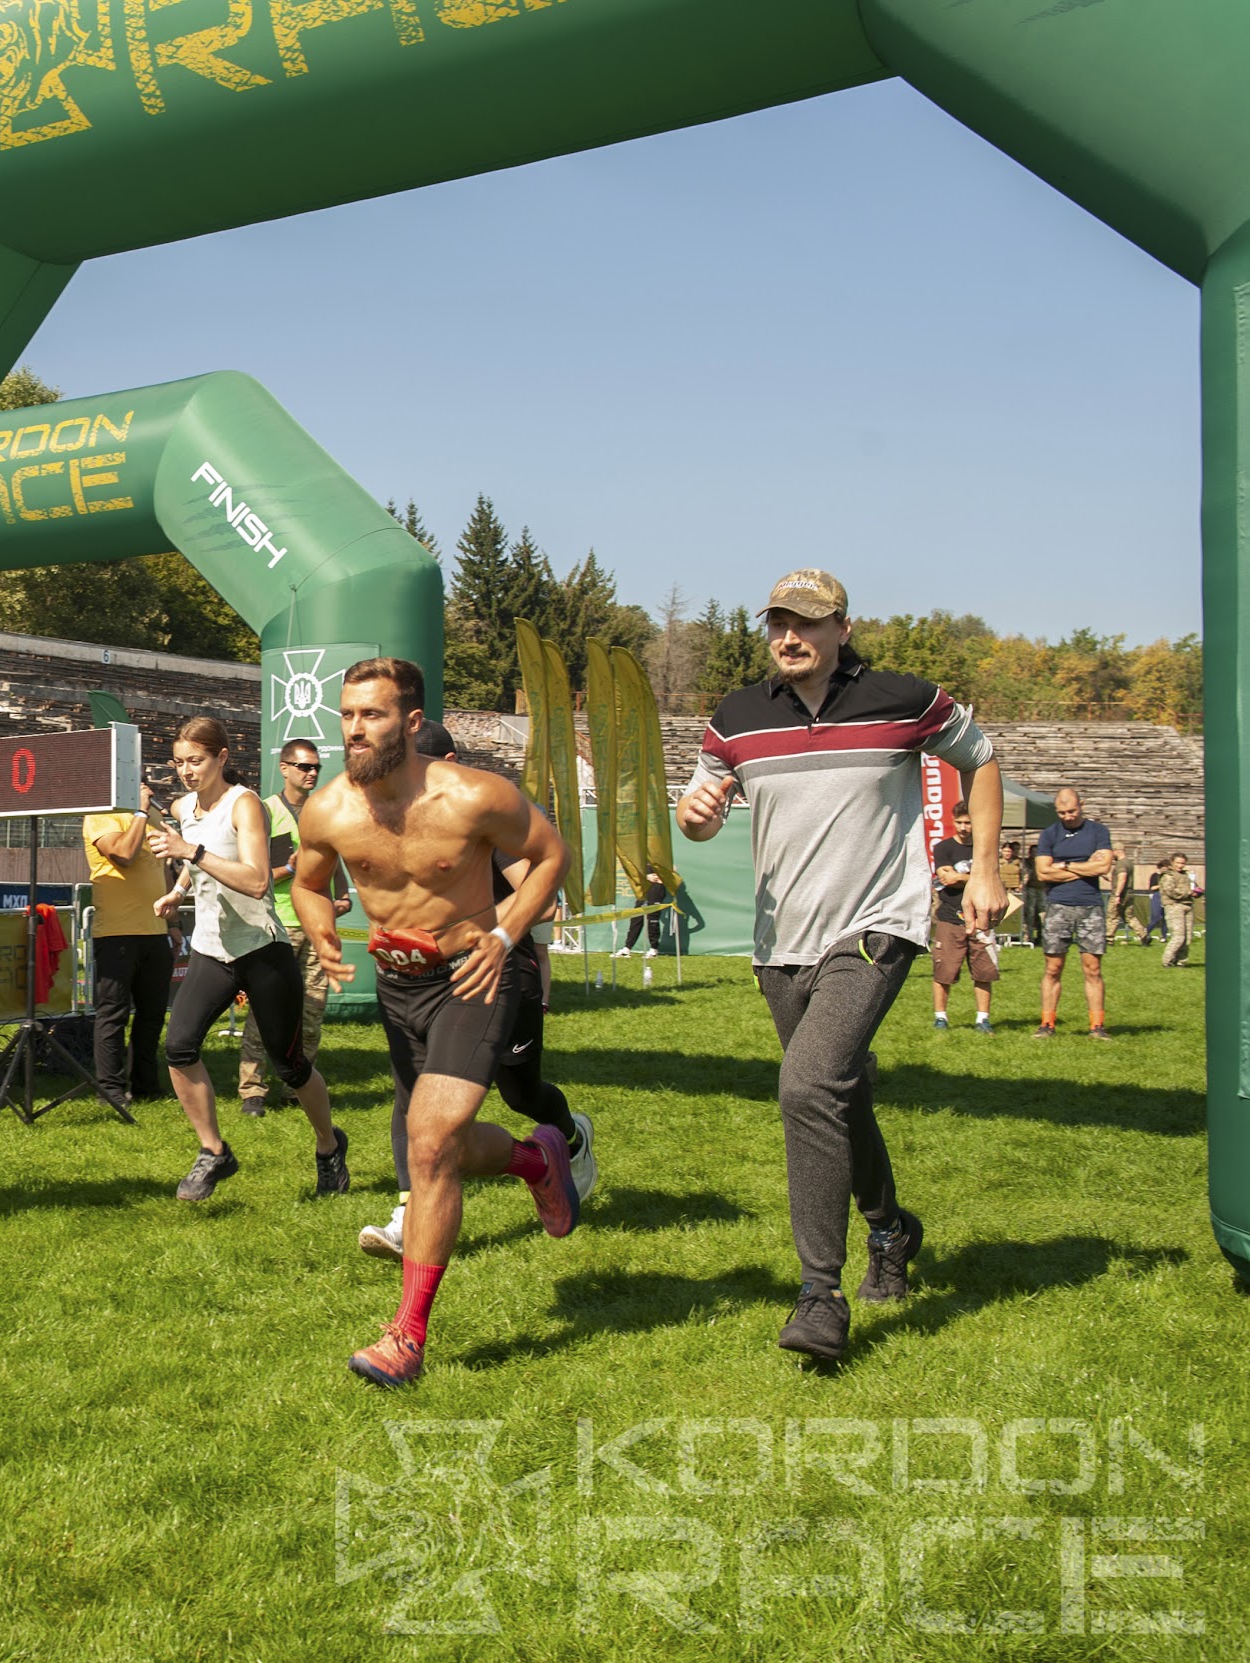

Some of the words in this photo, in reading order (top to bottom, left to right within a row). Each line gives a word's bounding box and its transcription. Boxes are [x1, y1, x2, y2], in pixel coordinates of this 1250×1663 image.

[190, 461, 288, 569] FINISH
[103, 649, 110, 663] 6
[12, 748, 36, 794] 0
[375, 948, 427, 966] 004
